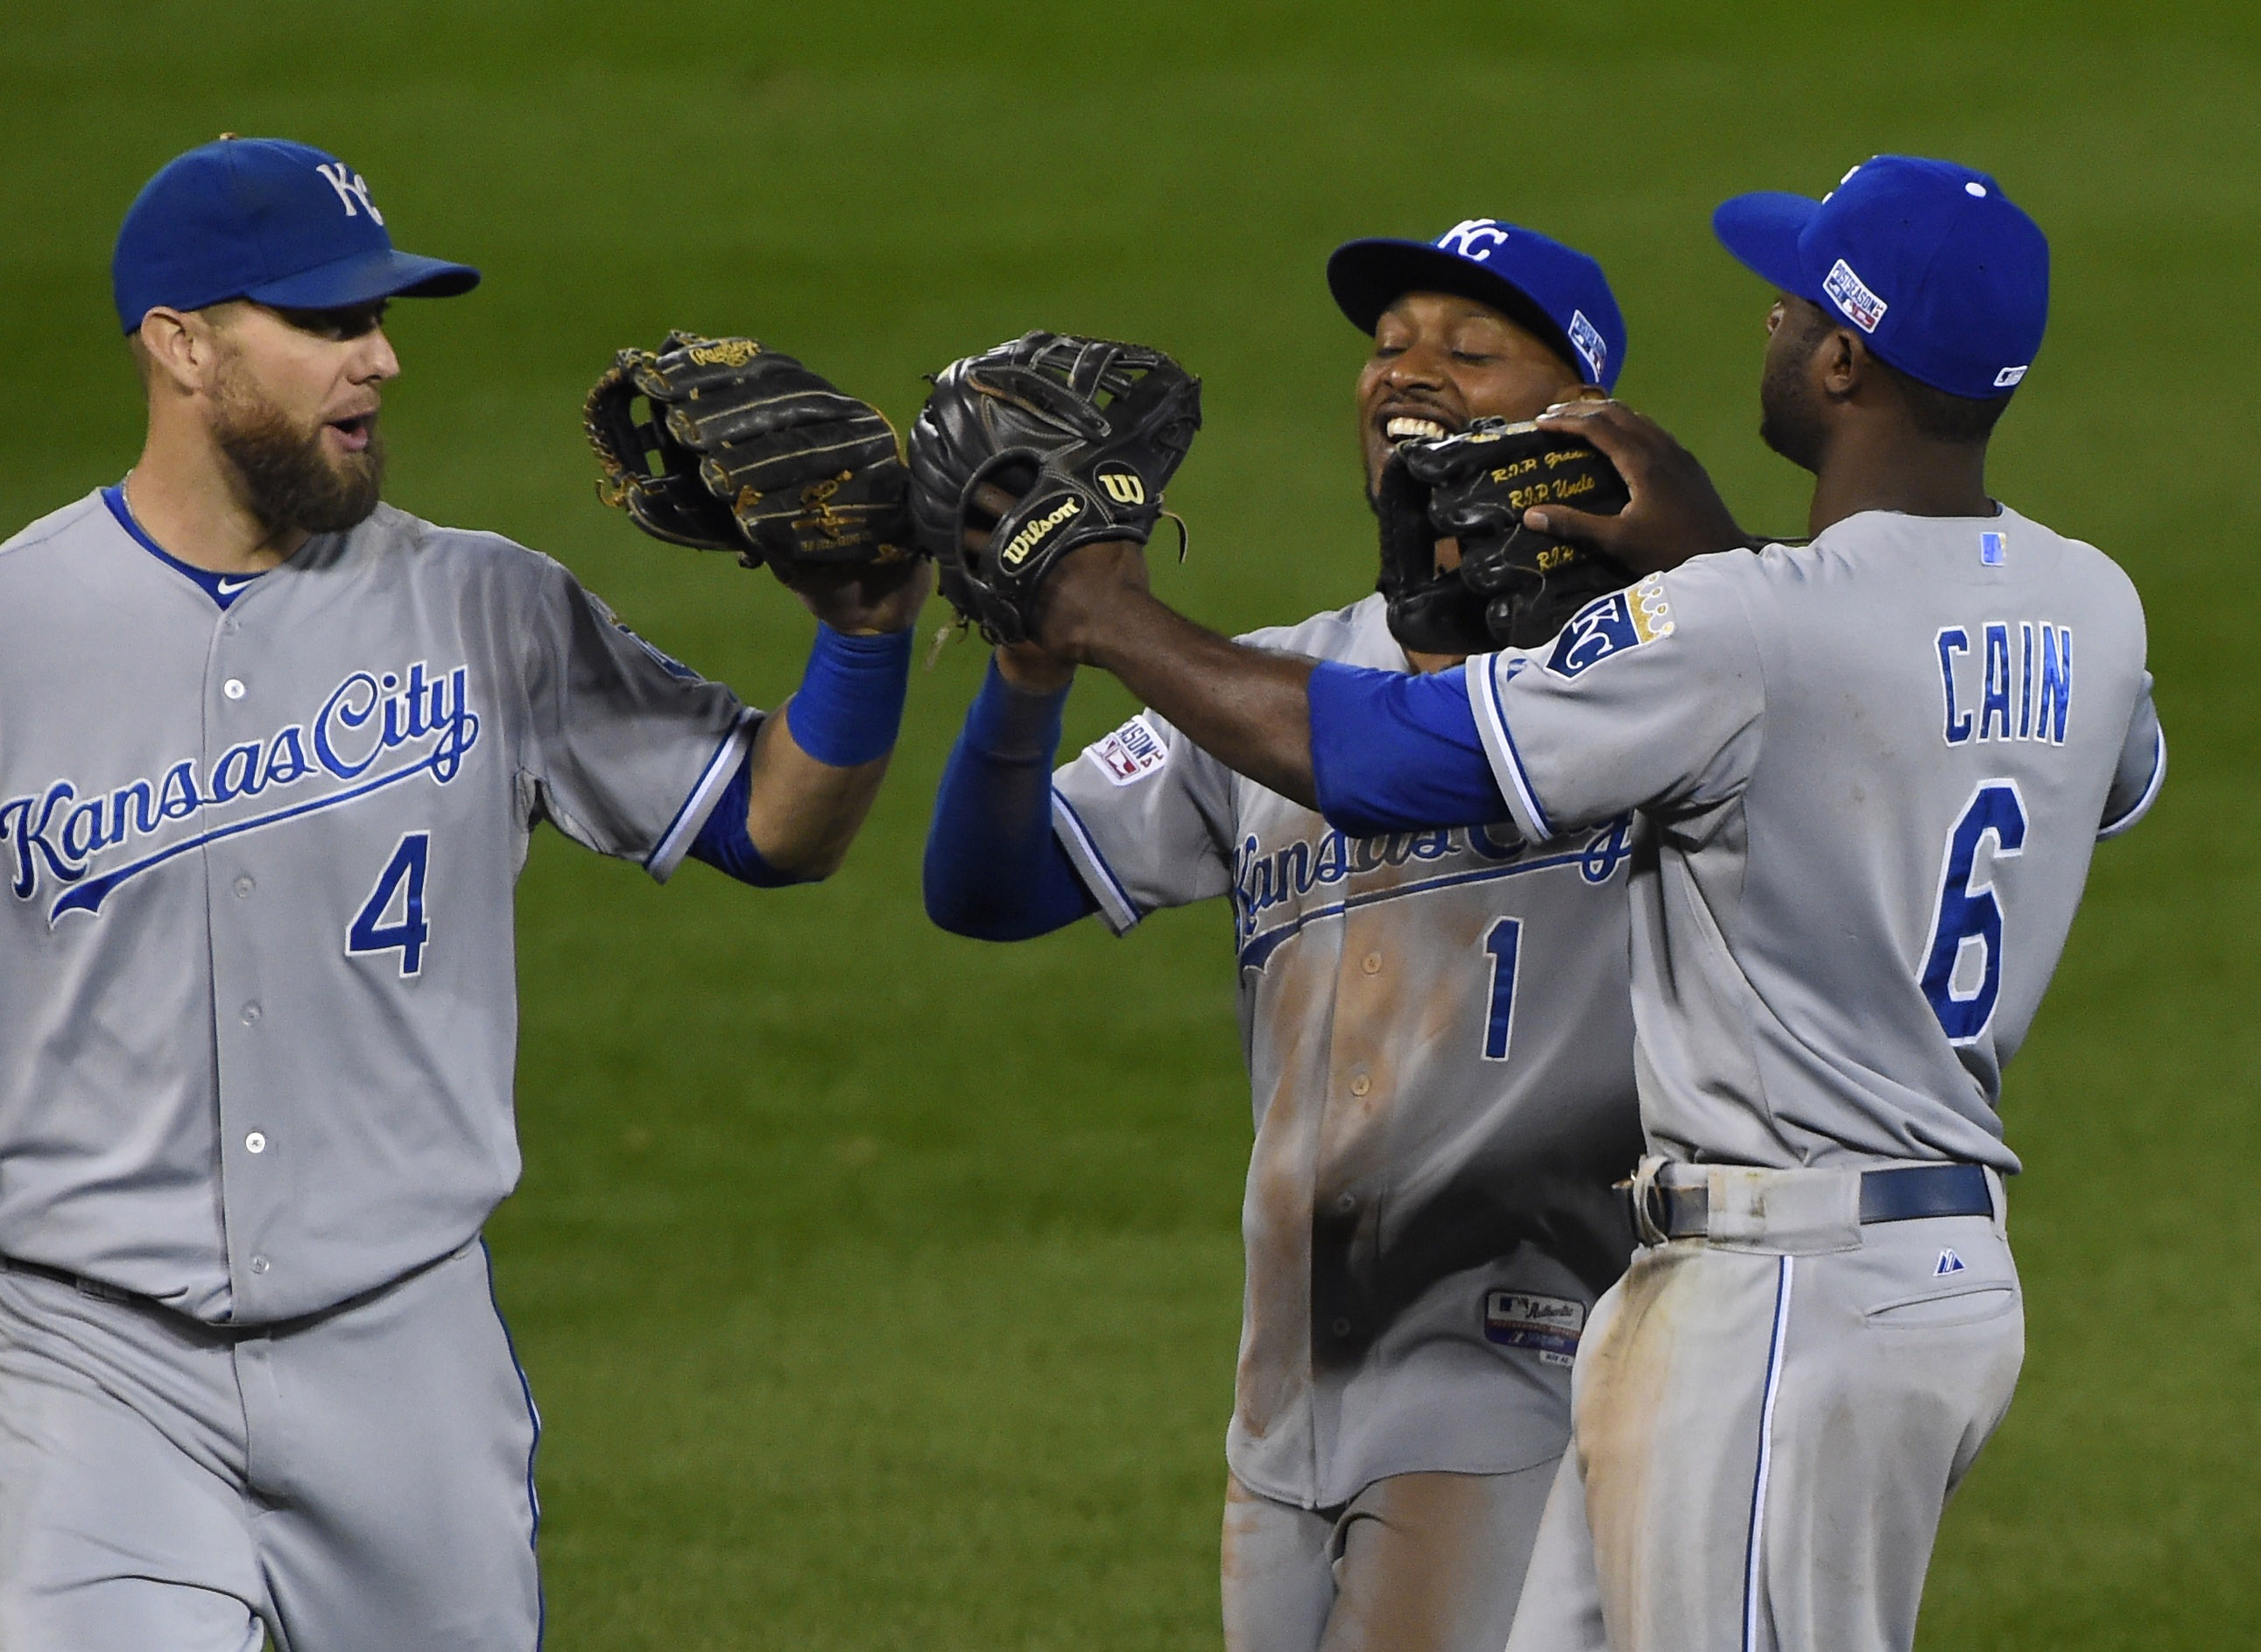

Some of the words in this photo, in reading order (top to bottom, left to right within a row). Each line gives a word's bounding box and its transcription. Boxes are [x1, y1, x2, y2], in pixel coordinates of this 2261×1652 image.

[1437, 218, 1509, 262] KC
[1833, 263, 1878, 313] POSTSEASON
[1003, 496, 1081, 565] Wilson
[1098, 474, 1145, 505] W
[1566, 598, 1620, 670] KC
[1933, 620, 2072, 747] CAIN
[0, 724, 318, 901] Kansas
[313, 659, 480, 785] City
[345, 829, 431, 979] 4
[1916, 777, 2028, 1047] 6
[1481, 915, 1525, 1063] 1
